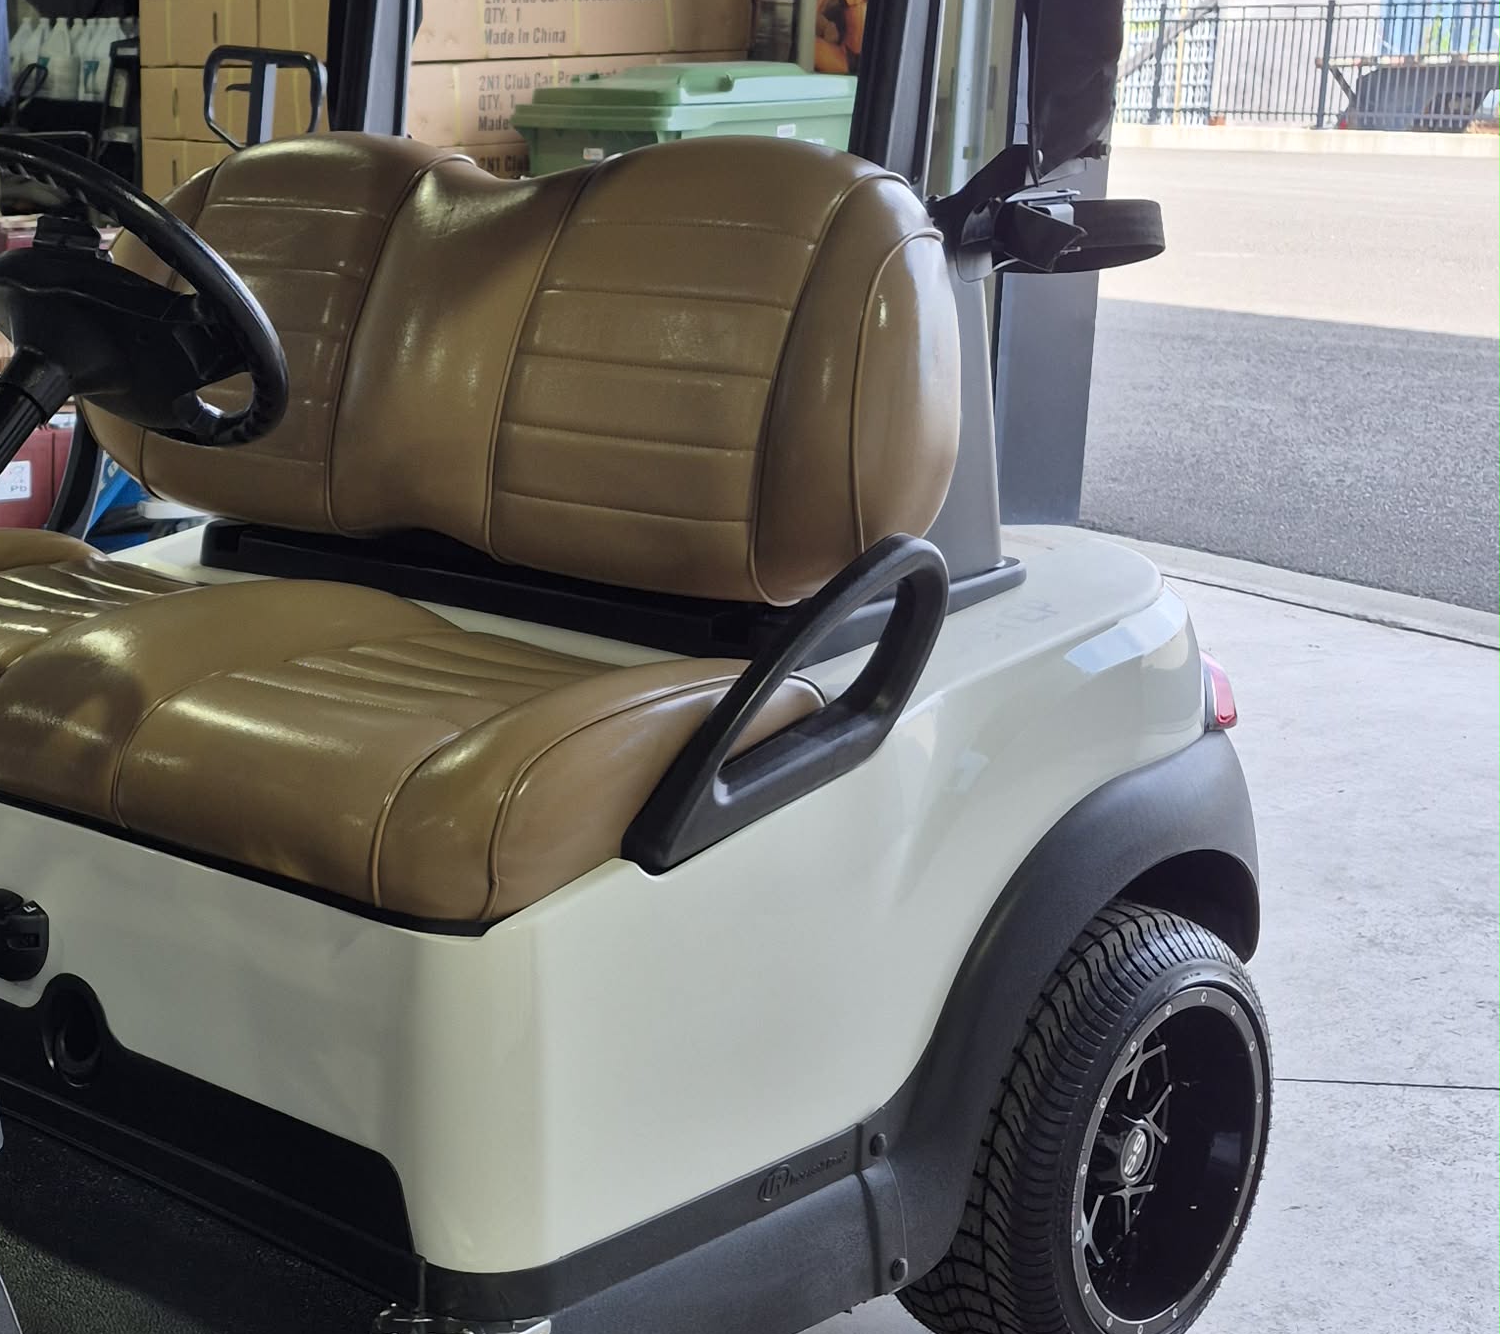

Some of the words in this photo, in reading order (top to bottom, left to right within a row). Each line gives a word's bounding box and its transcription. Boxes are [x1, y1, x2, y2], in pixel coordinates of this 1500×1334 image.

[484, 28, 514, 45] Made
[532, 27, 566, 44] China
[504, 74, 530, 91] Club
[478, 115, 509, 131] Made
